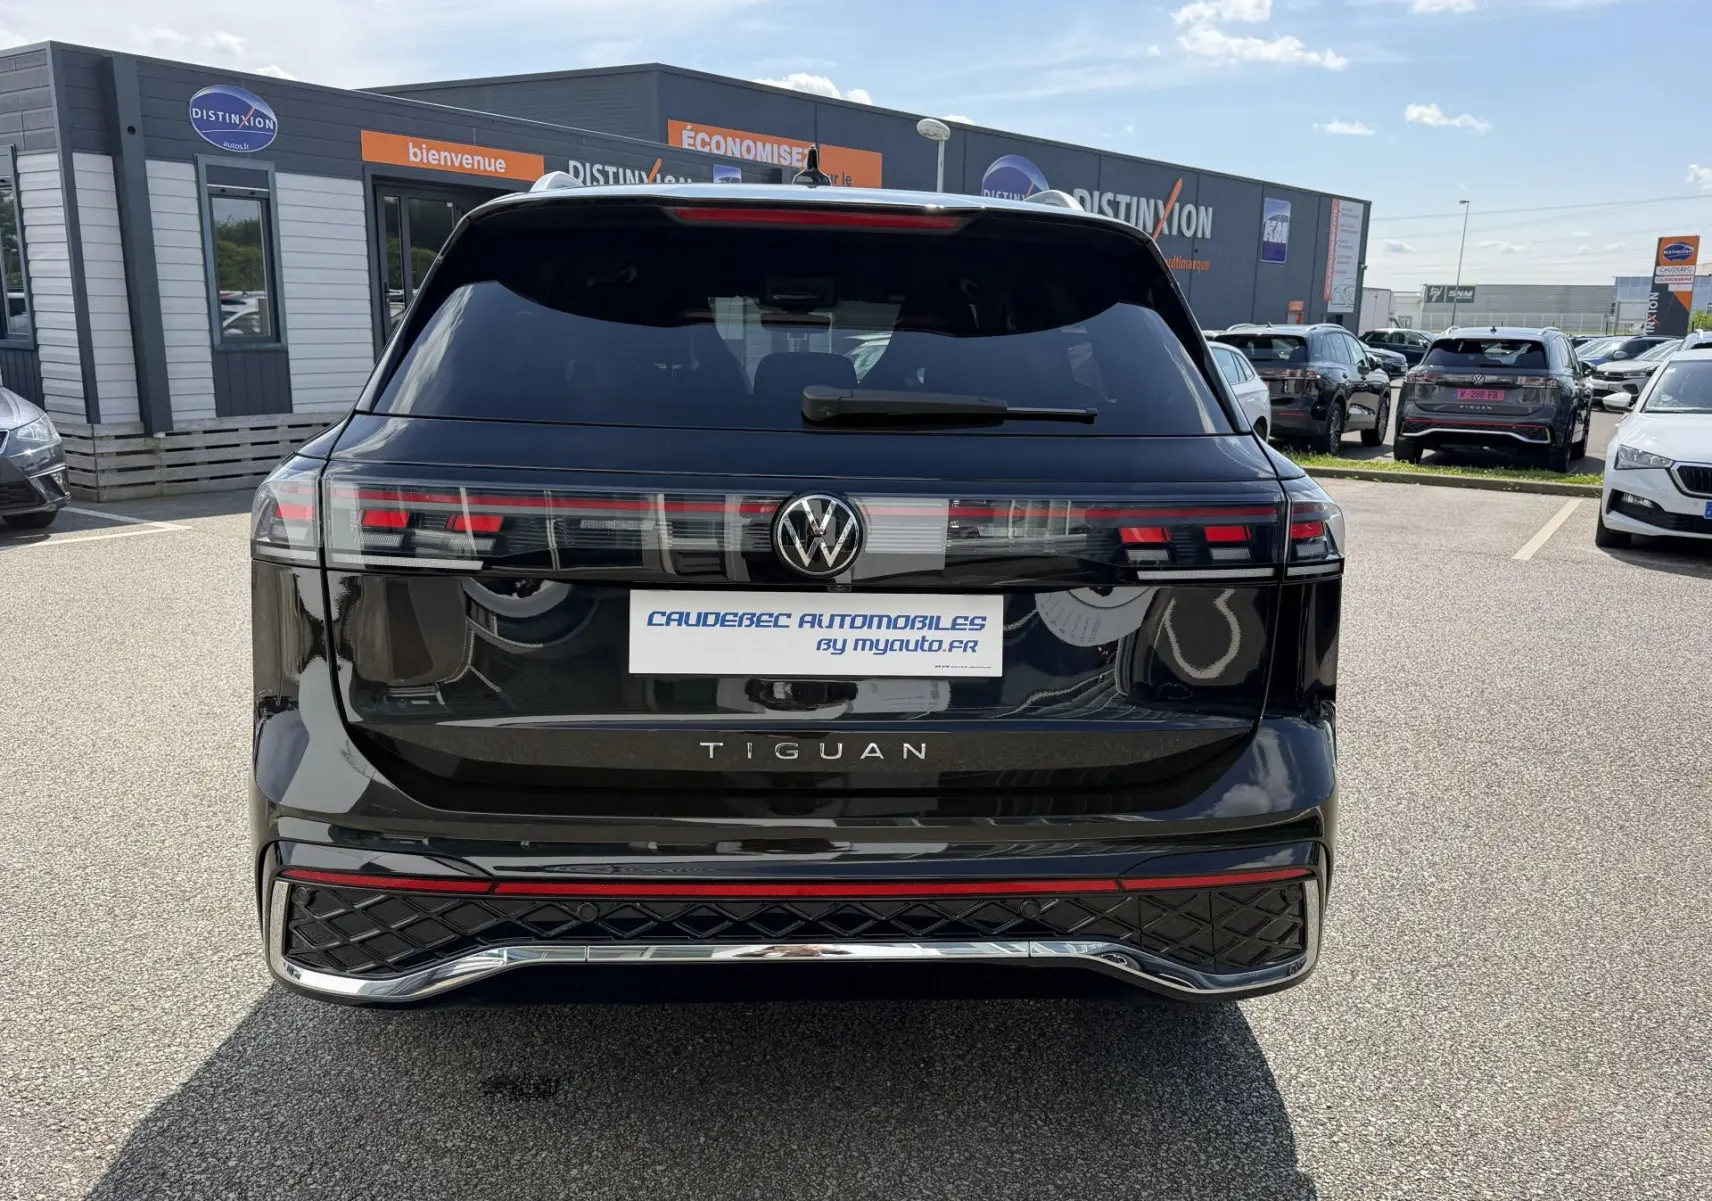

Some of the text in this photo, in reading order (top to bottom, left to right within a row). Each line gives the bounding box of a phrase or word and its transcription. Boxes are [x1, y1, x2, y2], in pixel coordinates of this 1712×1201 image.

[192, 107, 274, 130] DISTINXION
[408, 142, 506, 173] bienvenue
[842, 172, 852, 185] le
[1072, 178, 1213, 240] DISTINXION
[1166, 256, 1211, 273] ultimarque
[647, 611, 987, 632] CAUDEBEC AUTOMOBILES
[700, 742, 926, 760] TIGUAN
